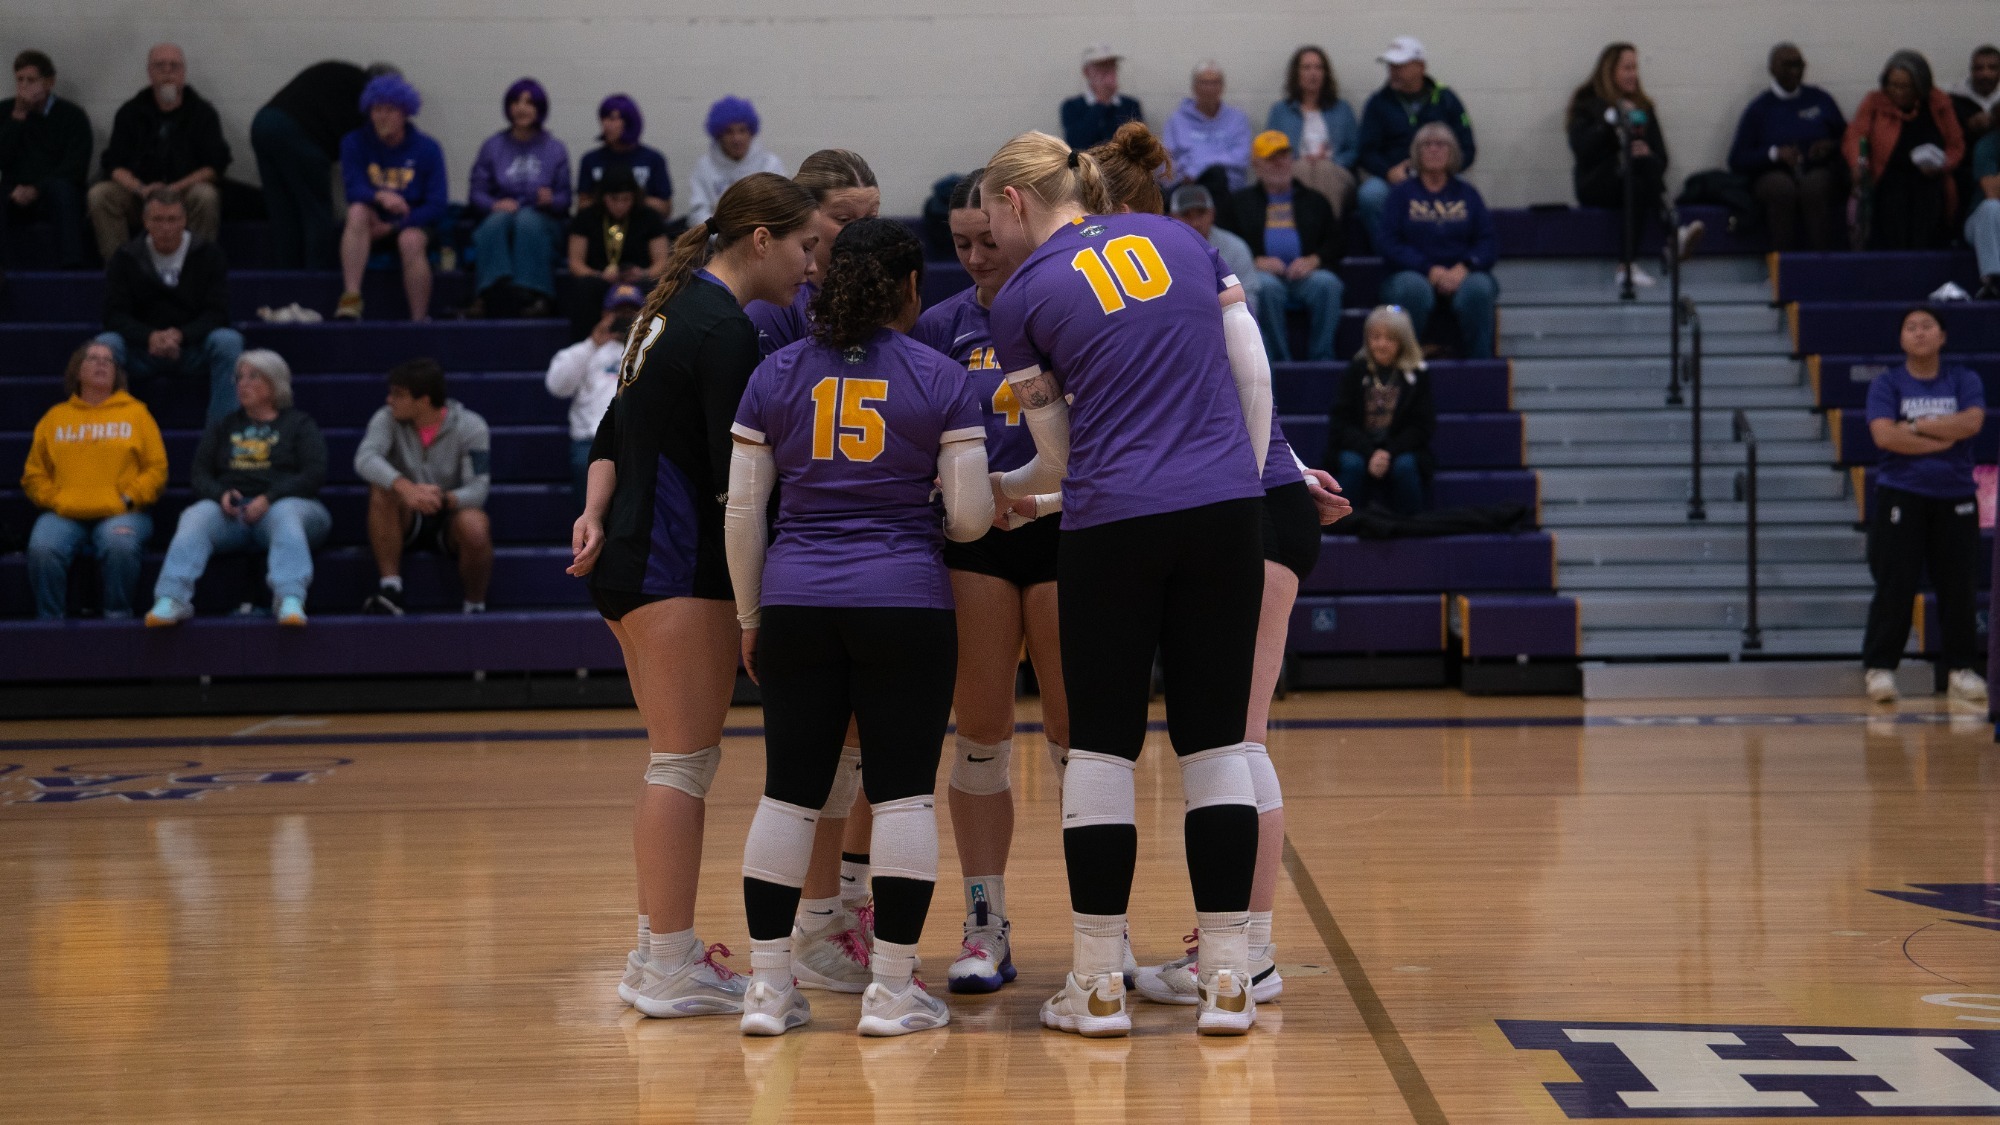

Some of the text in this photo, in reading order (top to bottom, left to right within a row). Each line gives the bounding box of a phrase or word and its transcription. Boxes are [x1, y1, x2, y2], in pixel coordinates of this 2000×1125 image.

[1071, 234, 1173, 315] 10
[968, 347, 1001, 371] AL
[811, 376, 889, 462] 15
[992, 378, 1024, 426] 4
[55, 421, 132, 442] ALFRED
